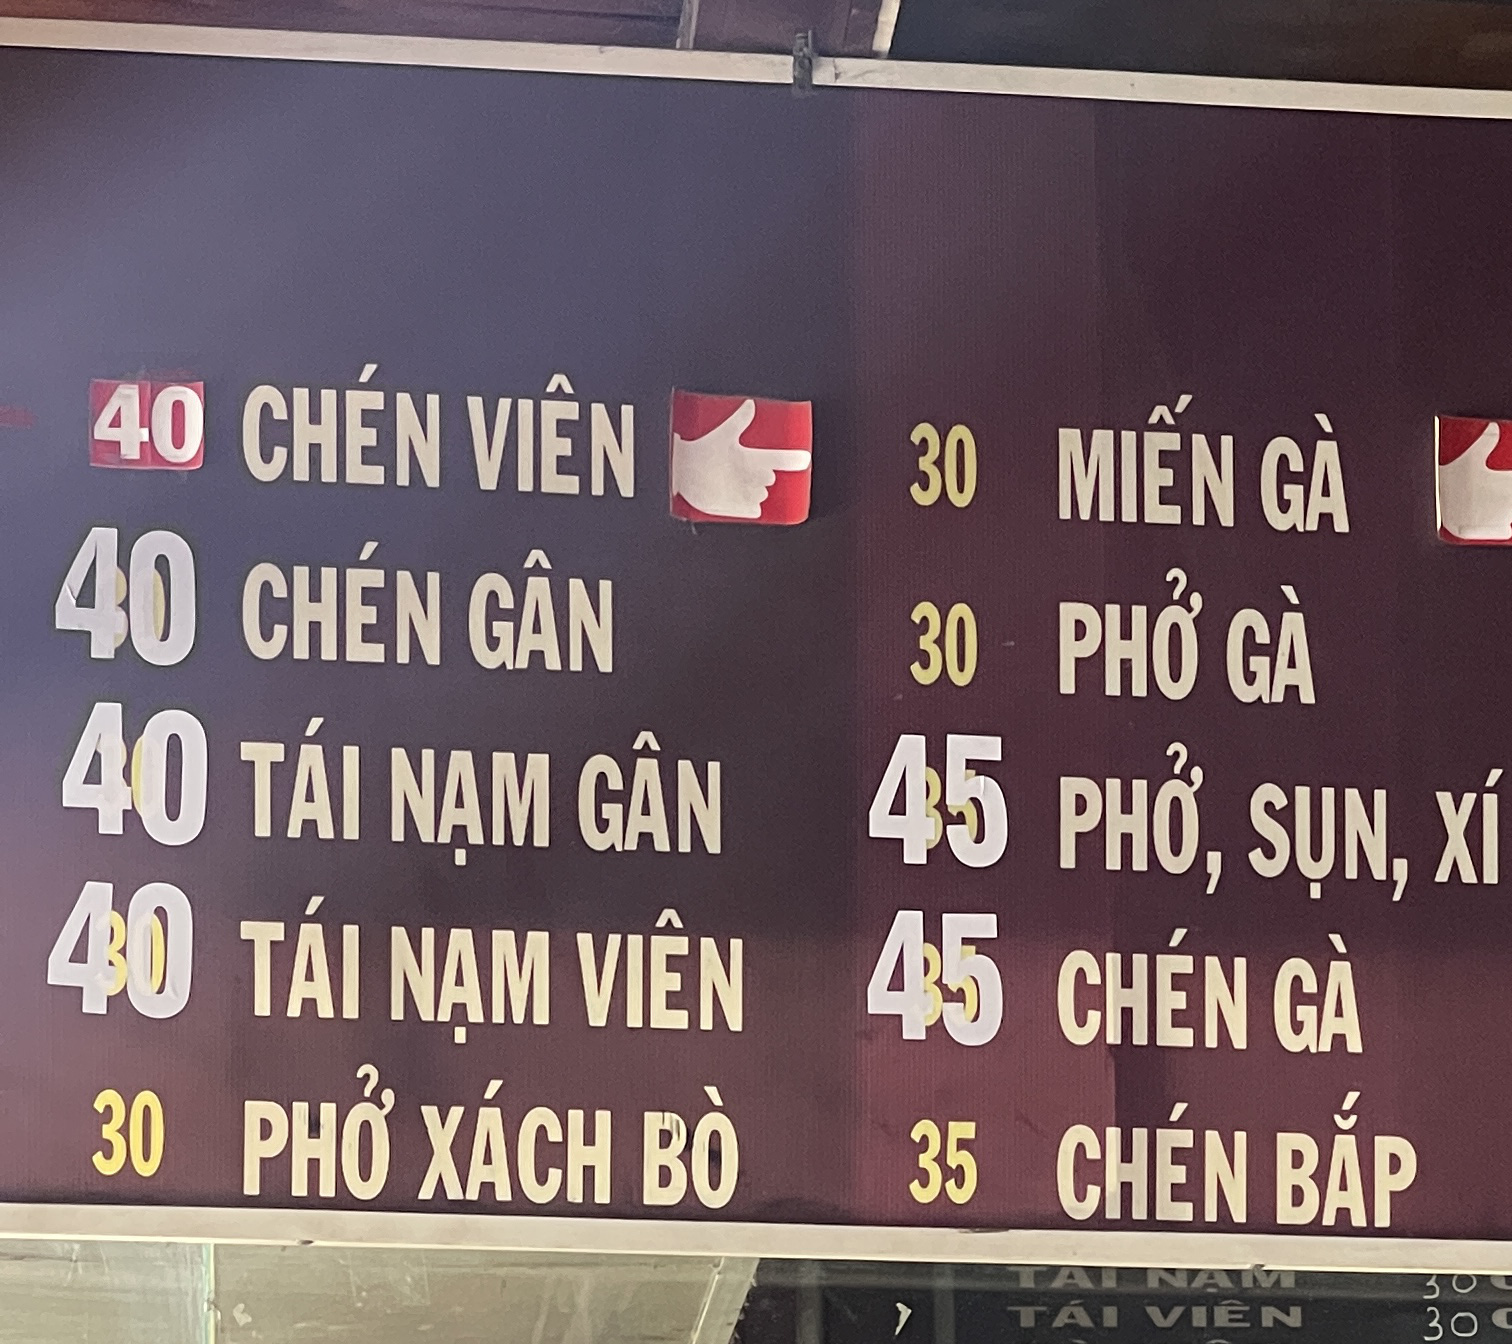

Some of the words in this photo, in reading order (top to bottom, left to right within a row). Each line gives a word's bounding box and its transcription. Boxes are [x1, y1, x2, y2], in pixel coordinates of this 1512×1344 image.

[93, 384, 202, 463] 40
[243, 365, 440, 487] CHÉN
[468, 374, 635, 497] VIÊN
[910, 423, 977, 507] 30
[1058, 394, 1234, 526] MIẾN
[1260, 413, 1350, 533] GÀ
[54, 528, 197, 666] 40
[243, 541, 440, 664] CHÉN
[469, 550, 613, 673] GÂN
[910, 602, 977, 686] 30
[1059, 568, 1203, 700] PHỞ
[1226, 585, 1316, 704] GÀ
[62, 702, 209, 845] 40
[240, 718, 359, 839] TÁI
[391, 748, 550, 866] NẠM
[578, 732, 722, 854] GÂN
[869, 735, 1008, 867] 45
[1059, 742, 1222, 894] PHỞ,
[1250, 784, 1408, 901] SỤN,
[1436, 769, 1504, 884] XÍ
[47, 882, 193, 1019] 40
[240, 897, 359, 1019] TÁI
[391, 927, 550, 1043] NẠM
[577, 910, 743, 1032] VIÊN
[867, 910, 1003, 1046] 45
[1058, 929, 1248, 1049] CHÉN
[1274, 934, 1363, 1053] GÀ
[92, 1090, 164, 1177] 30
[243, 1065, 395, 1197] PHỞ
[418, 1081, 611, 1204] XÁCH
[643, 1087, 740, 1209] BÒ
[910, 1121, 977, 1204] 35
[1058, 1103, 1248, 1225] CHÉN
[1277, 1092, 1417, 1229] BẮP
[1007, 1300, 1118, 1328] TÁI
[1145, 1300, 1302, 1328] VIÊN
[1423, 1306, 1478, 1341] 30
